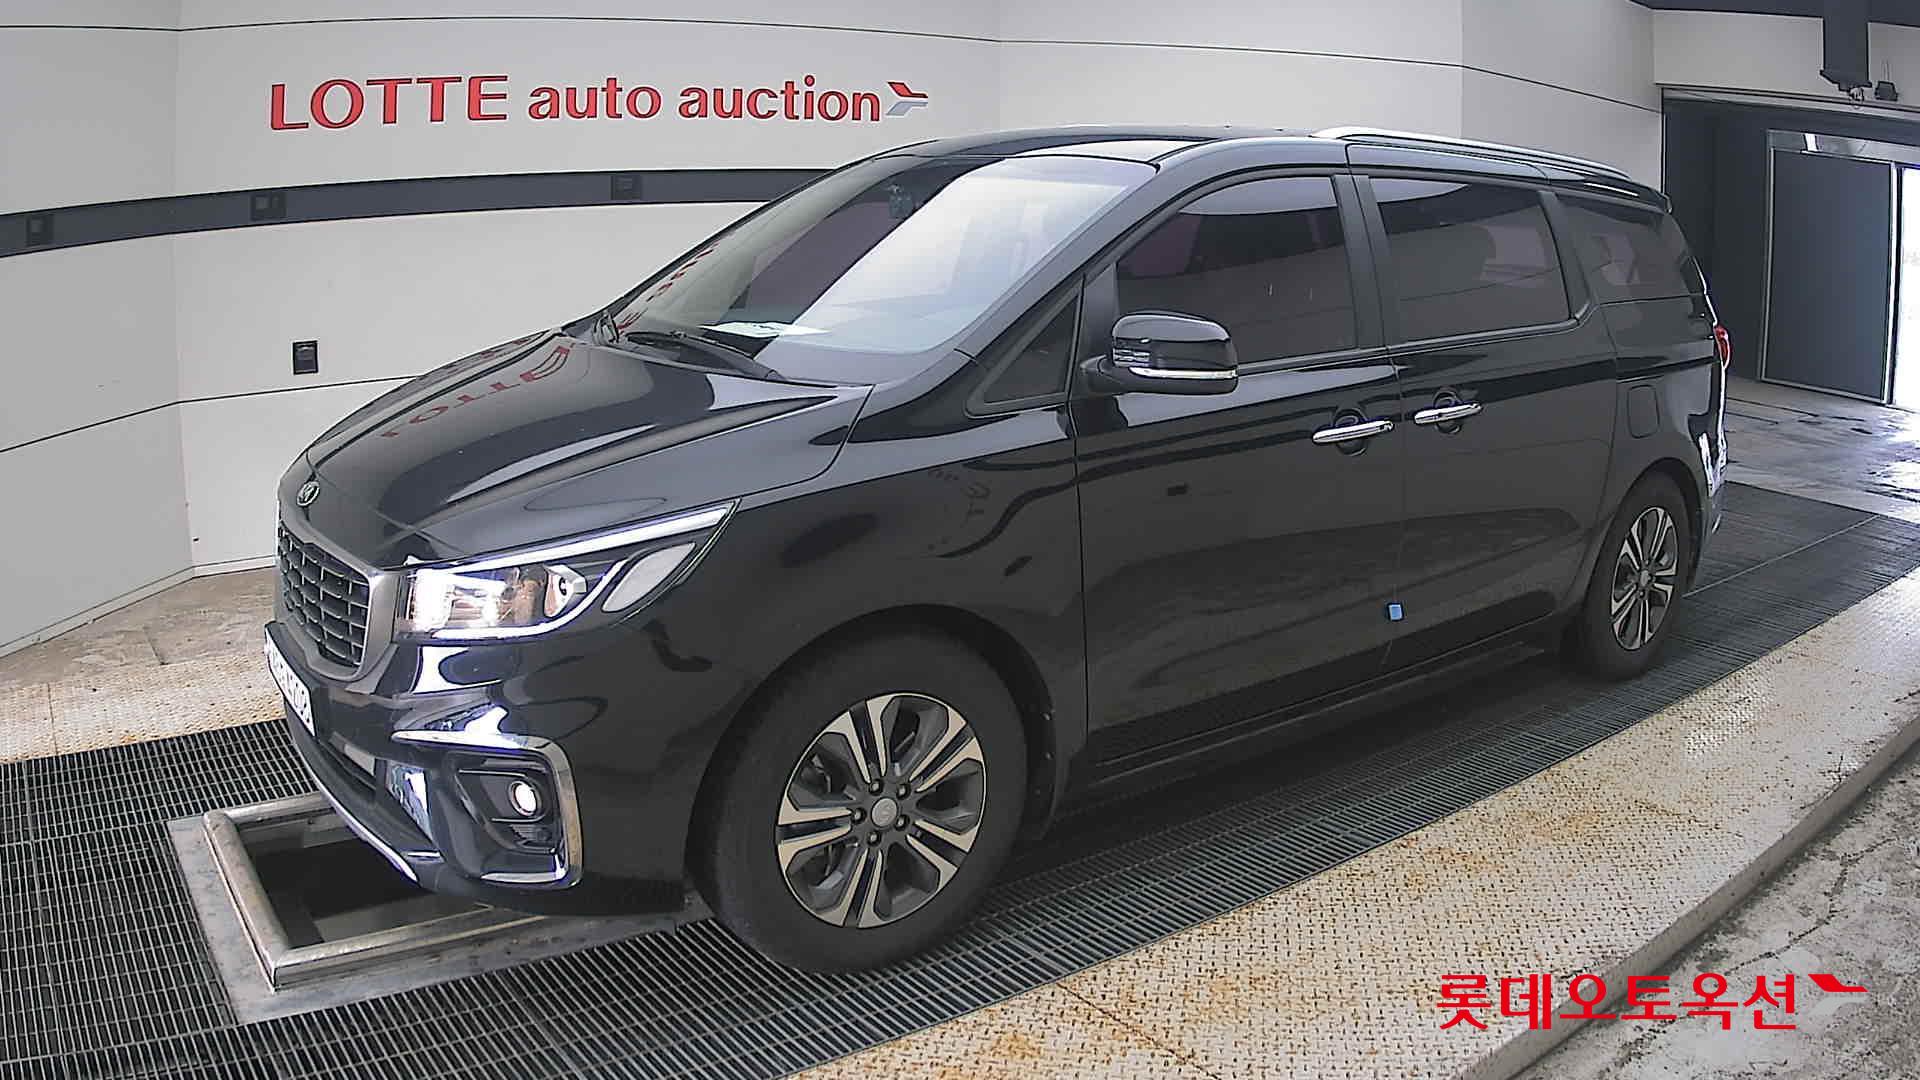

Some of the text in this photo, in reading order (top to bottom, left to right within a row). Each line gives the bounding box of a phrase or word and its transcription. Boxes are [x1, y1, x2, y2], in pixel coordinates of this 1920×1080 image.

[269, 73, 882, 131] LOTTE auto auction
